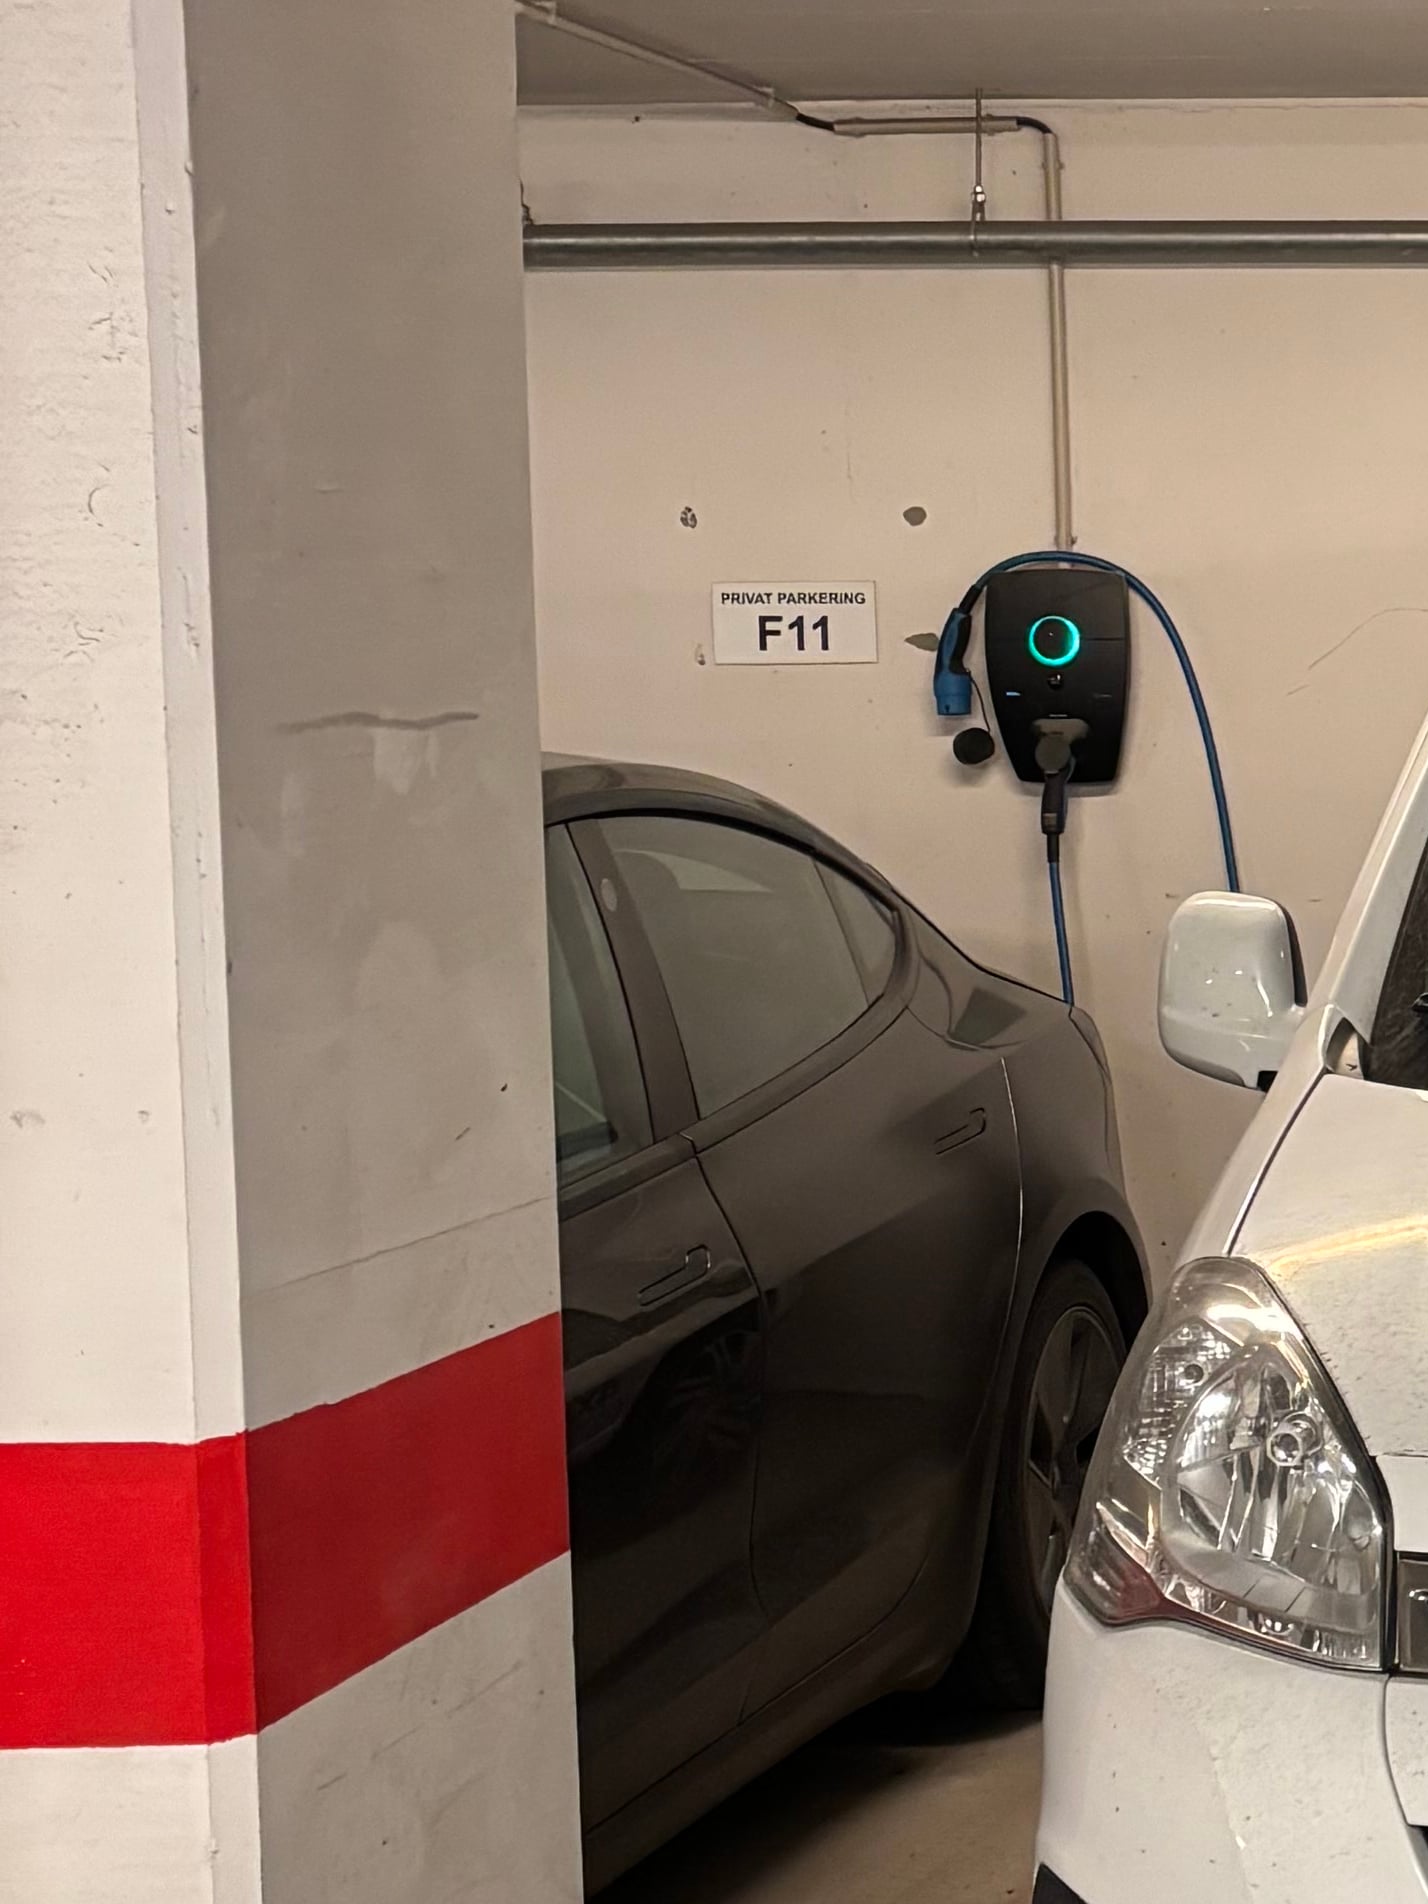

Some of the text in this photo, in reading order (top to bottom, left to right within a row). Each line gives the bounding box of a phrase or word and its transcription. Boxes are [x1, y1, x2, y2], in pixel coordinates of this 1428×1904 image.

[720, 592, 867, 605] PRIVAT PARKERING
[758, 615, 830, 652] F11
